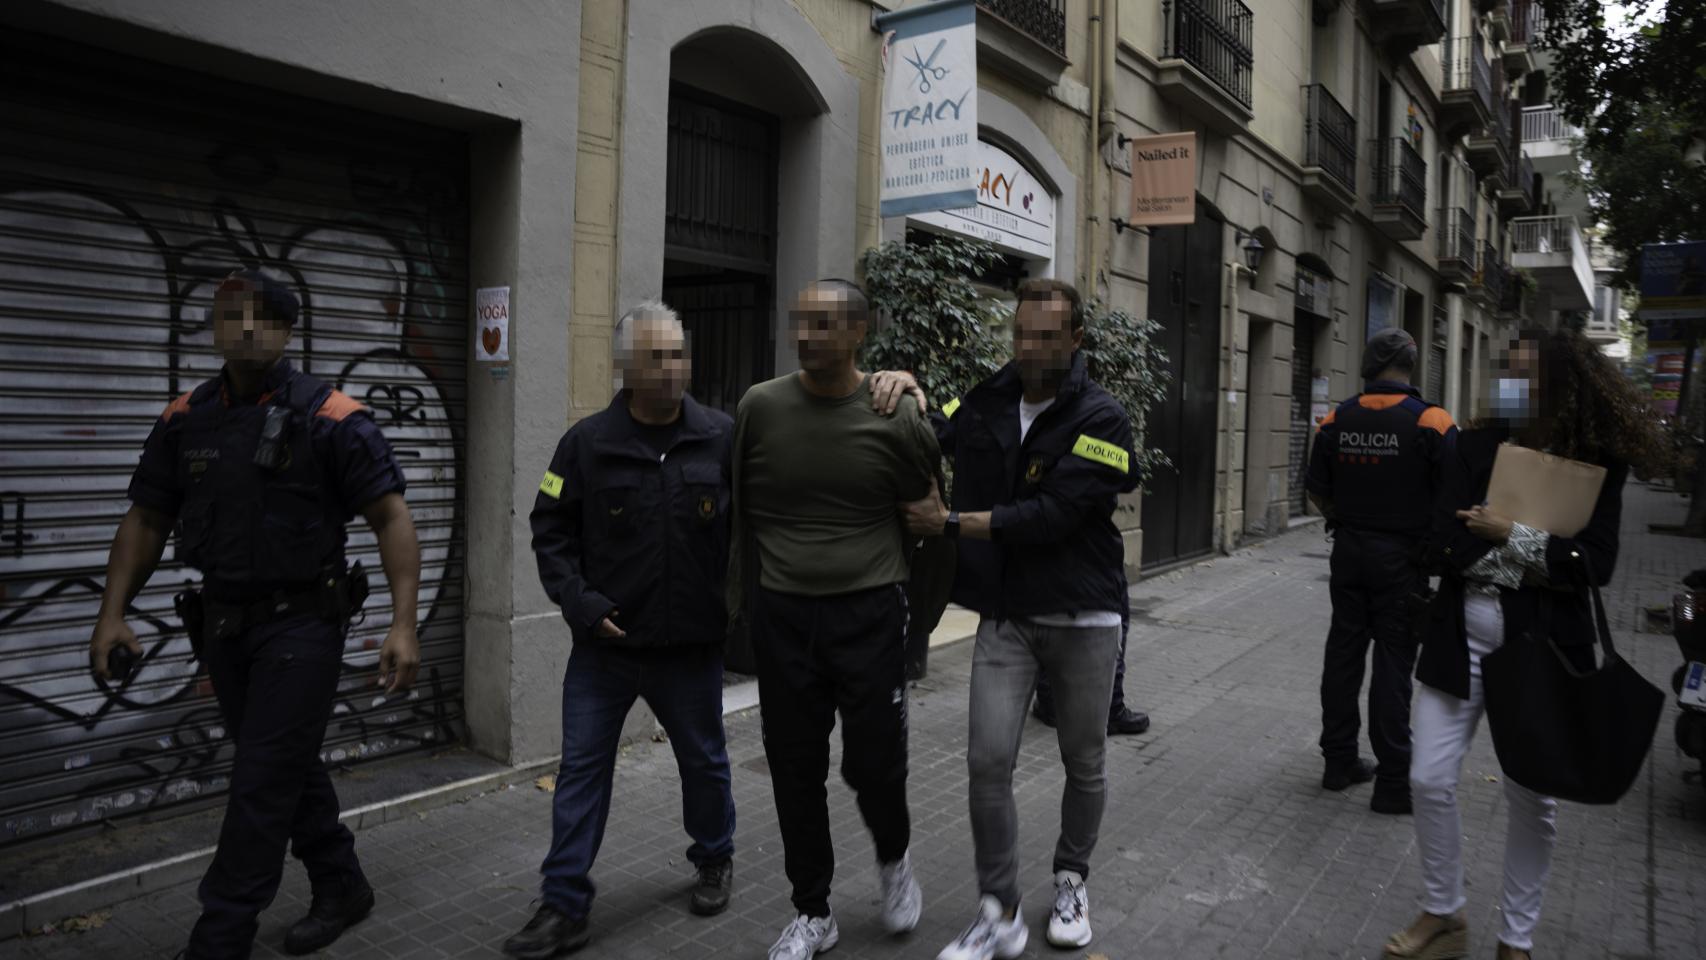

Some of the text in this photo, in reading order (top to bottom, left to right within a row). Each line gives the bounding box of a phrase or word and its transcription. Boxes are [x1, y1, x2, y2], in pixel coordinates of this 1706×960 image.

[889, 88, 971, 129] TRACY
[1138, 146, 1189, 162] Nailed it
[478, 304, 508, 320] YOGA
[1339, 431, 1399, 448] POLICIA
[1086, 444, 1123, 464] POLICIA
